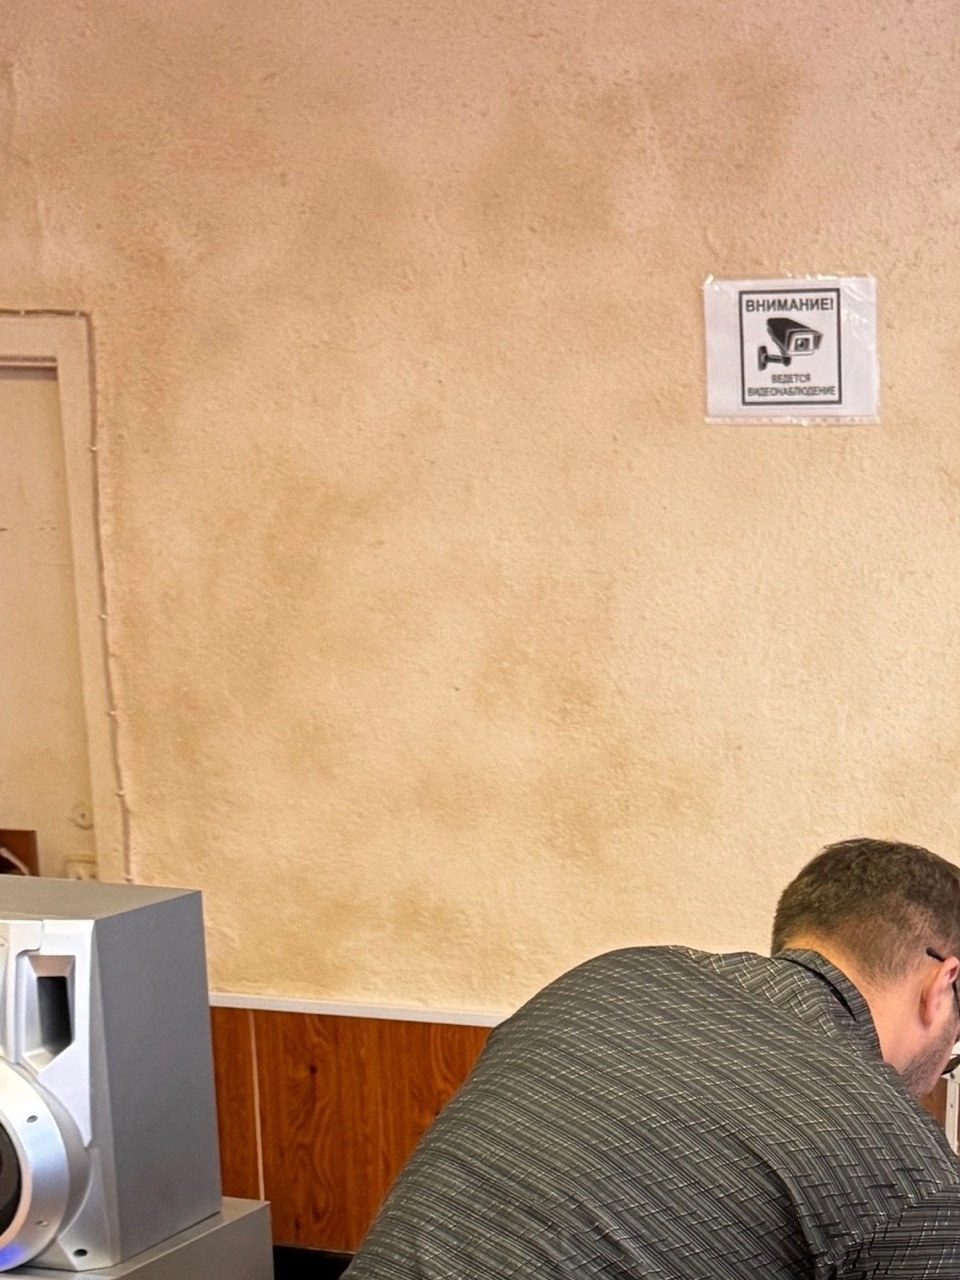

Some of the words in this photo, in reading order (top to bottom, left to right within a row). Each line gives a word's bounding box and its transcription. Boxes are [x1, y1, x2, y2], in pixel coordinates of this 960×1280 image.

[745, 298, 834, 312] ВНИМАНИЕ!
[772, 374, 811, 384] ВЕДЕТСЯ
[747, 386, 836, 396] ВИДЕОНАБЛЮДЕНИЕ
